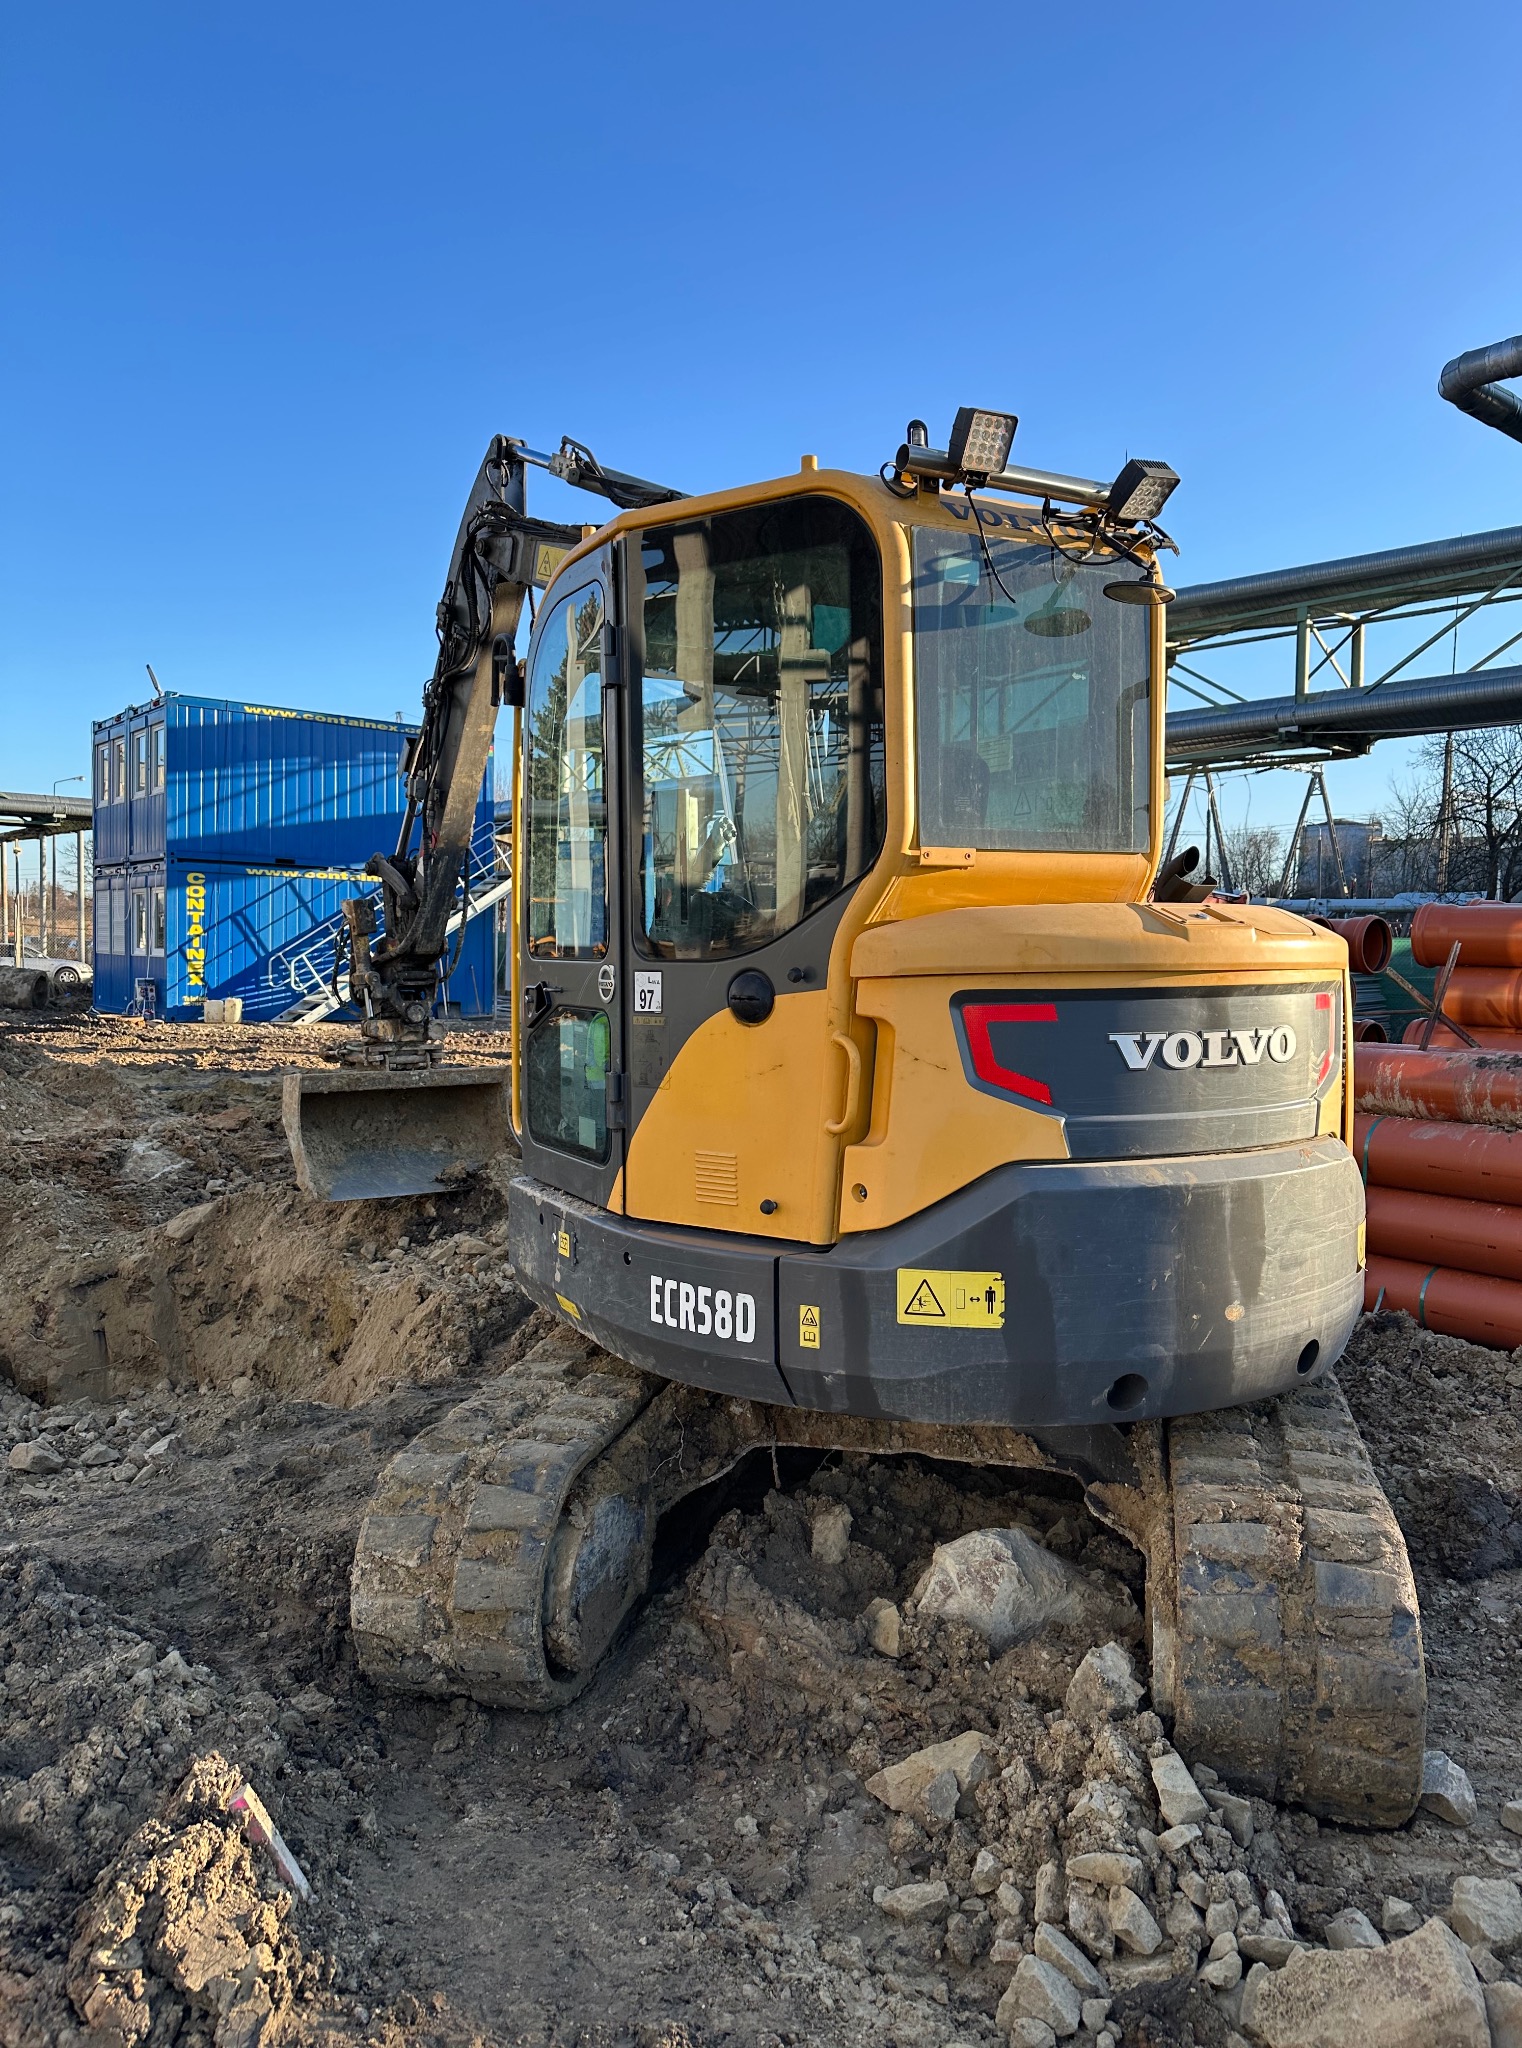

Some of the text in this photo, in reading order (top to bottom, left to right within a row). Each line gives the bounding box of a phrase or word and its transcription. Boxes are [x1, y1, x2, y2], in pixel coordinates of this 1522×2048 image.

[186, 872, 206, 986] CONTAINEX
[640, 989, 654, 1010] 97
[1108, 1025, 1297, 1070] VOLVO
[650, 1274, 756, 1343] ECR58D
